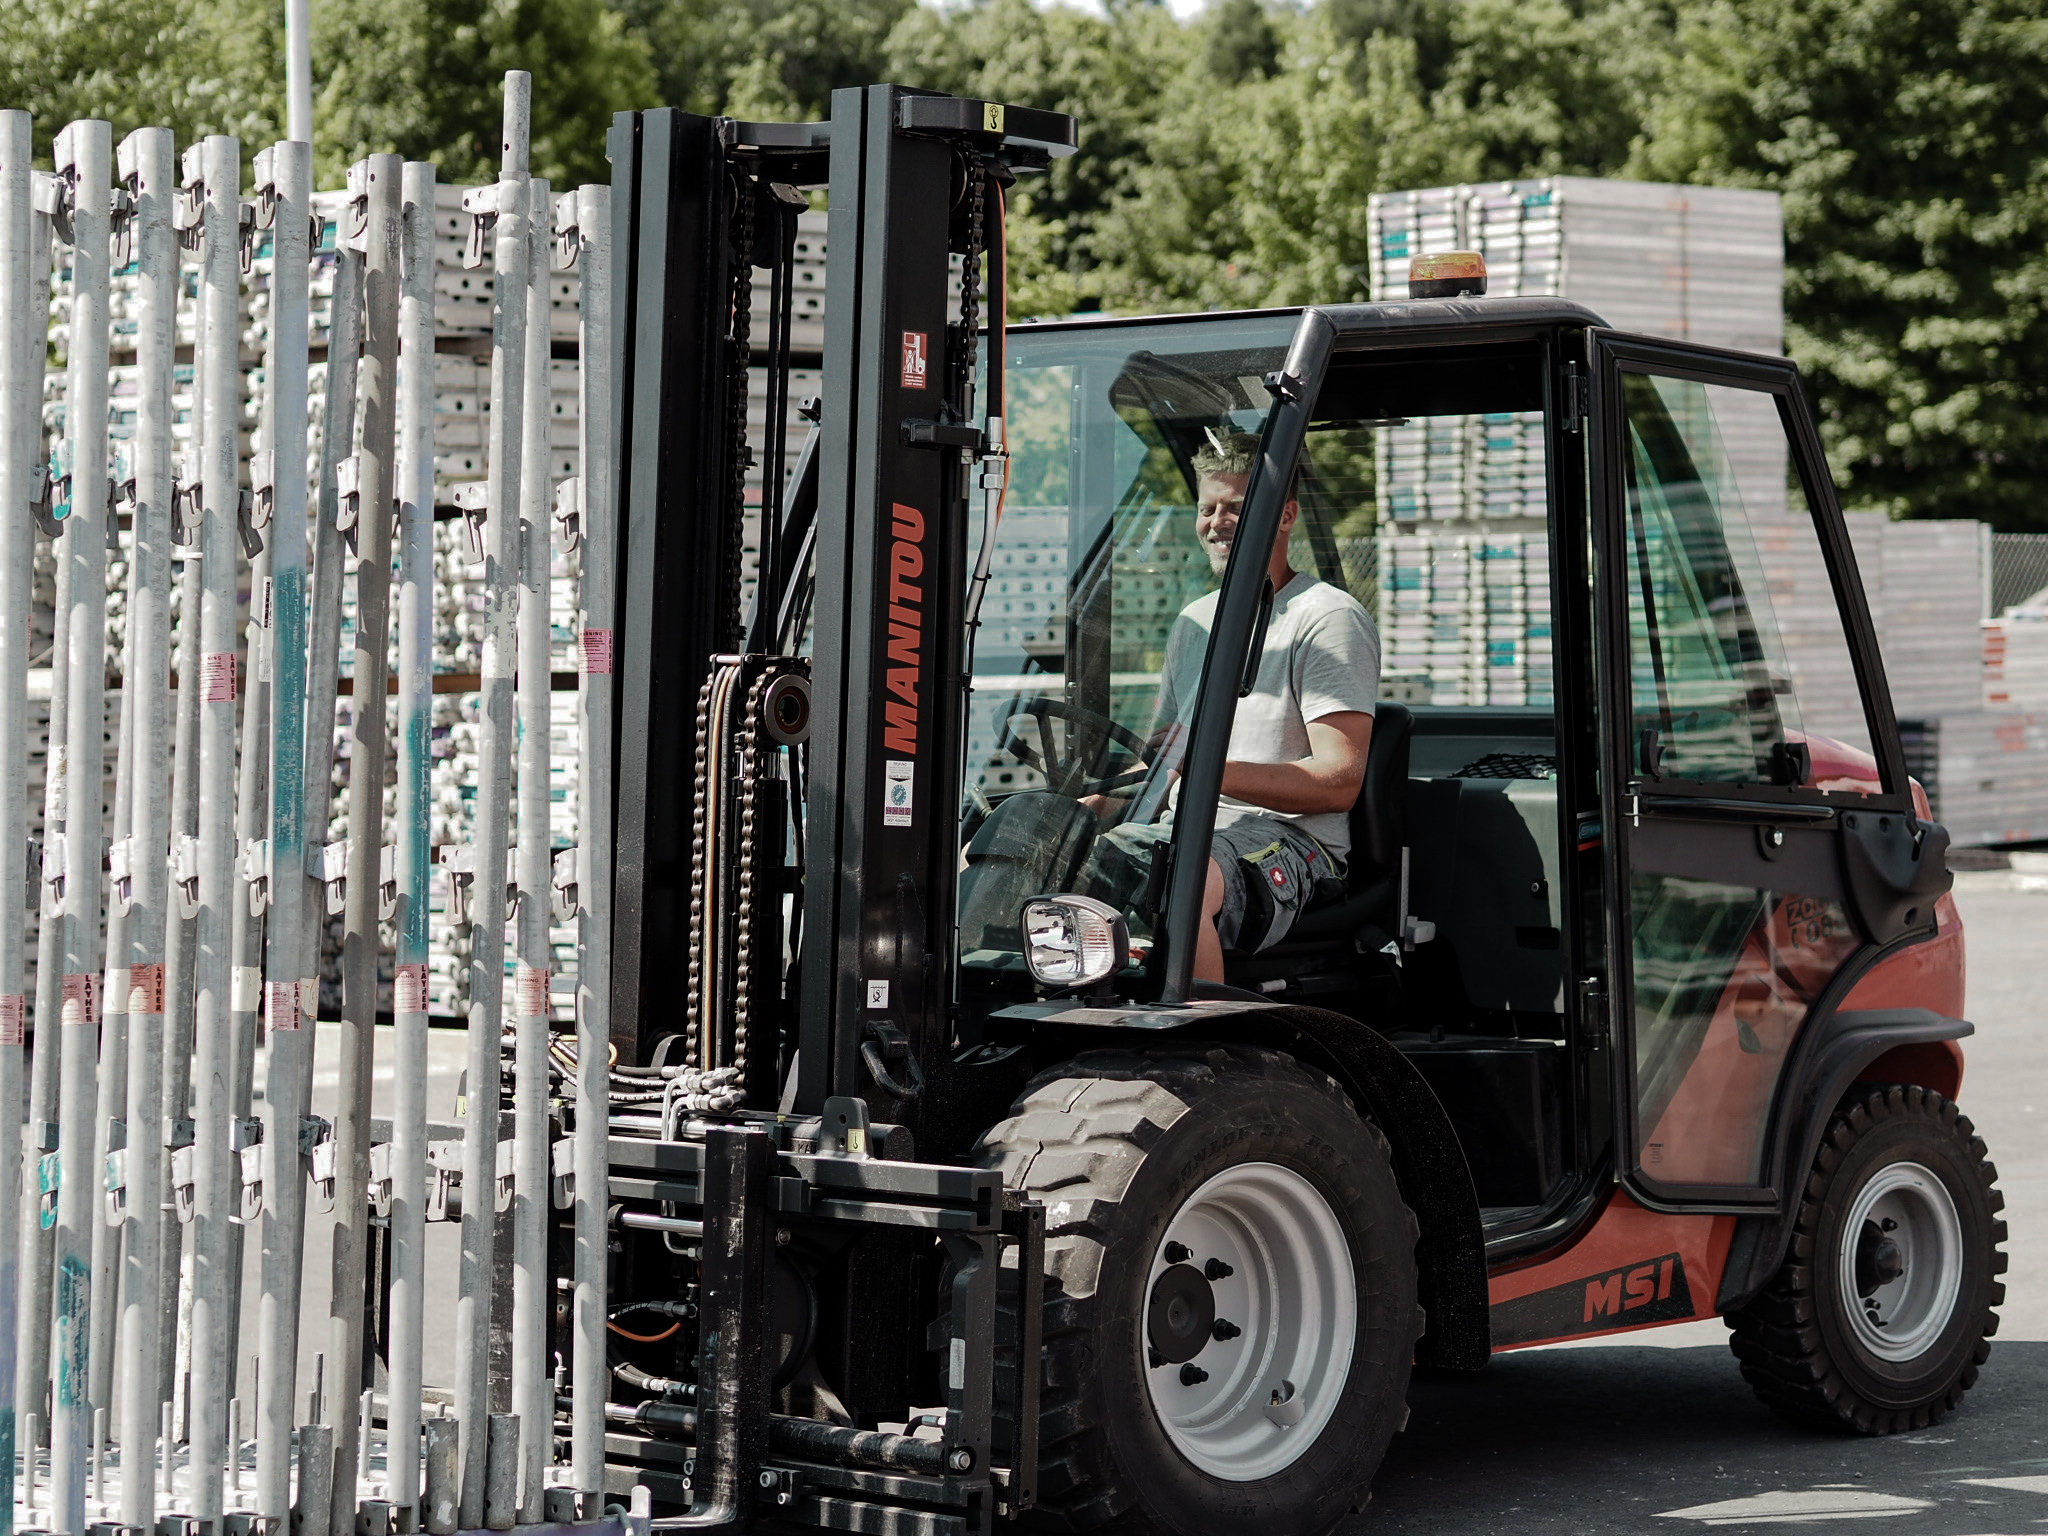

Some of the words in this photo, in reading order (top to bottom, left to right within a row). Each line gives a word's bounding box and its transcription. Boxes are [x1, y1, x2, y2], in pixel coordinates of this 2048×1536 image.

[884, 502, 925, 755] MANITOU
[84, 974, 92, 1023] LAYHER
[1584, 1259, 1674, 1323] MSI
